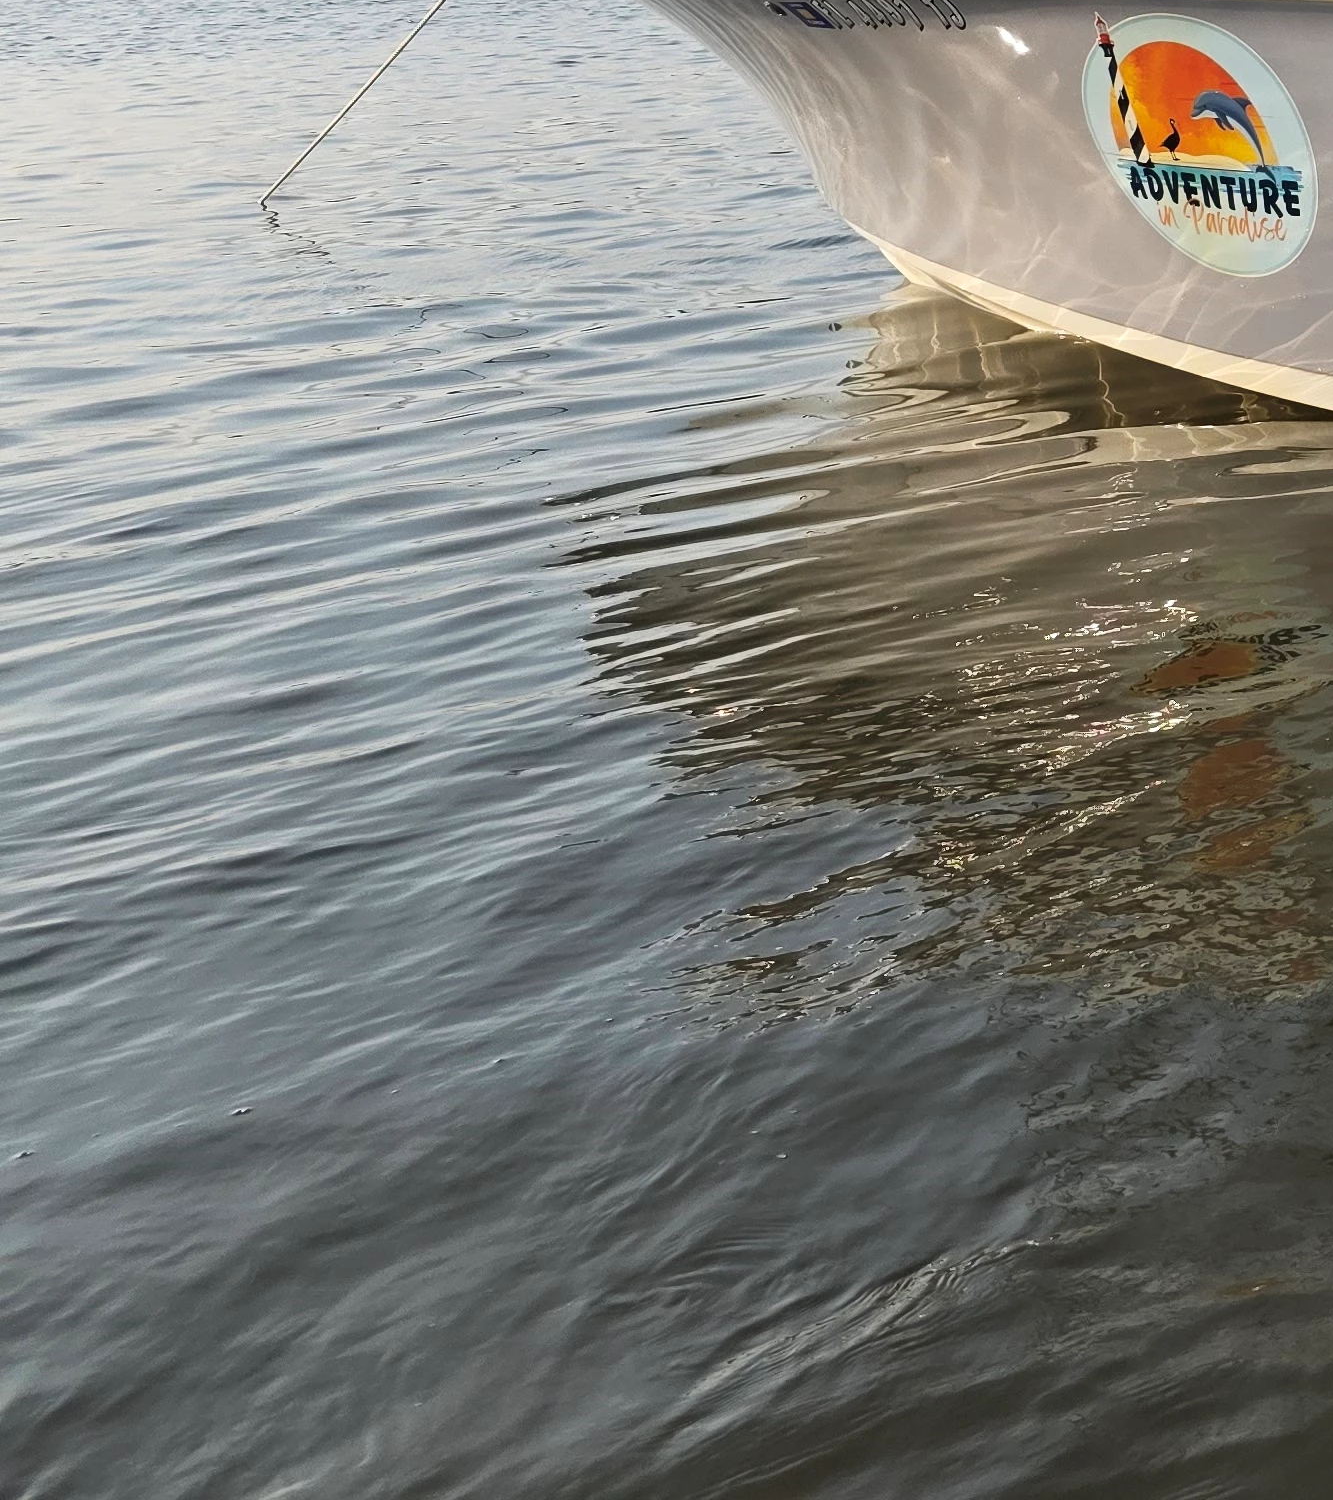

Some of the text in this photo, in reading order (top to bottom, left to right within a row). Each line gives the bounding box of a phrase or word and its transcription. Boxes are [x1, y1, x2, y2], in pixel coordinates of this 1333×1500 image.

[1129, 164, 1302, 219] ADVENTURE
[1156, 198, 1288, 243] in Paradise
